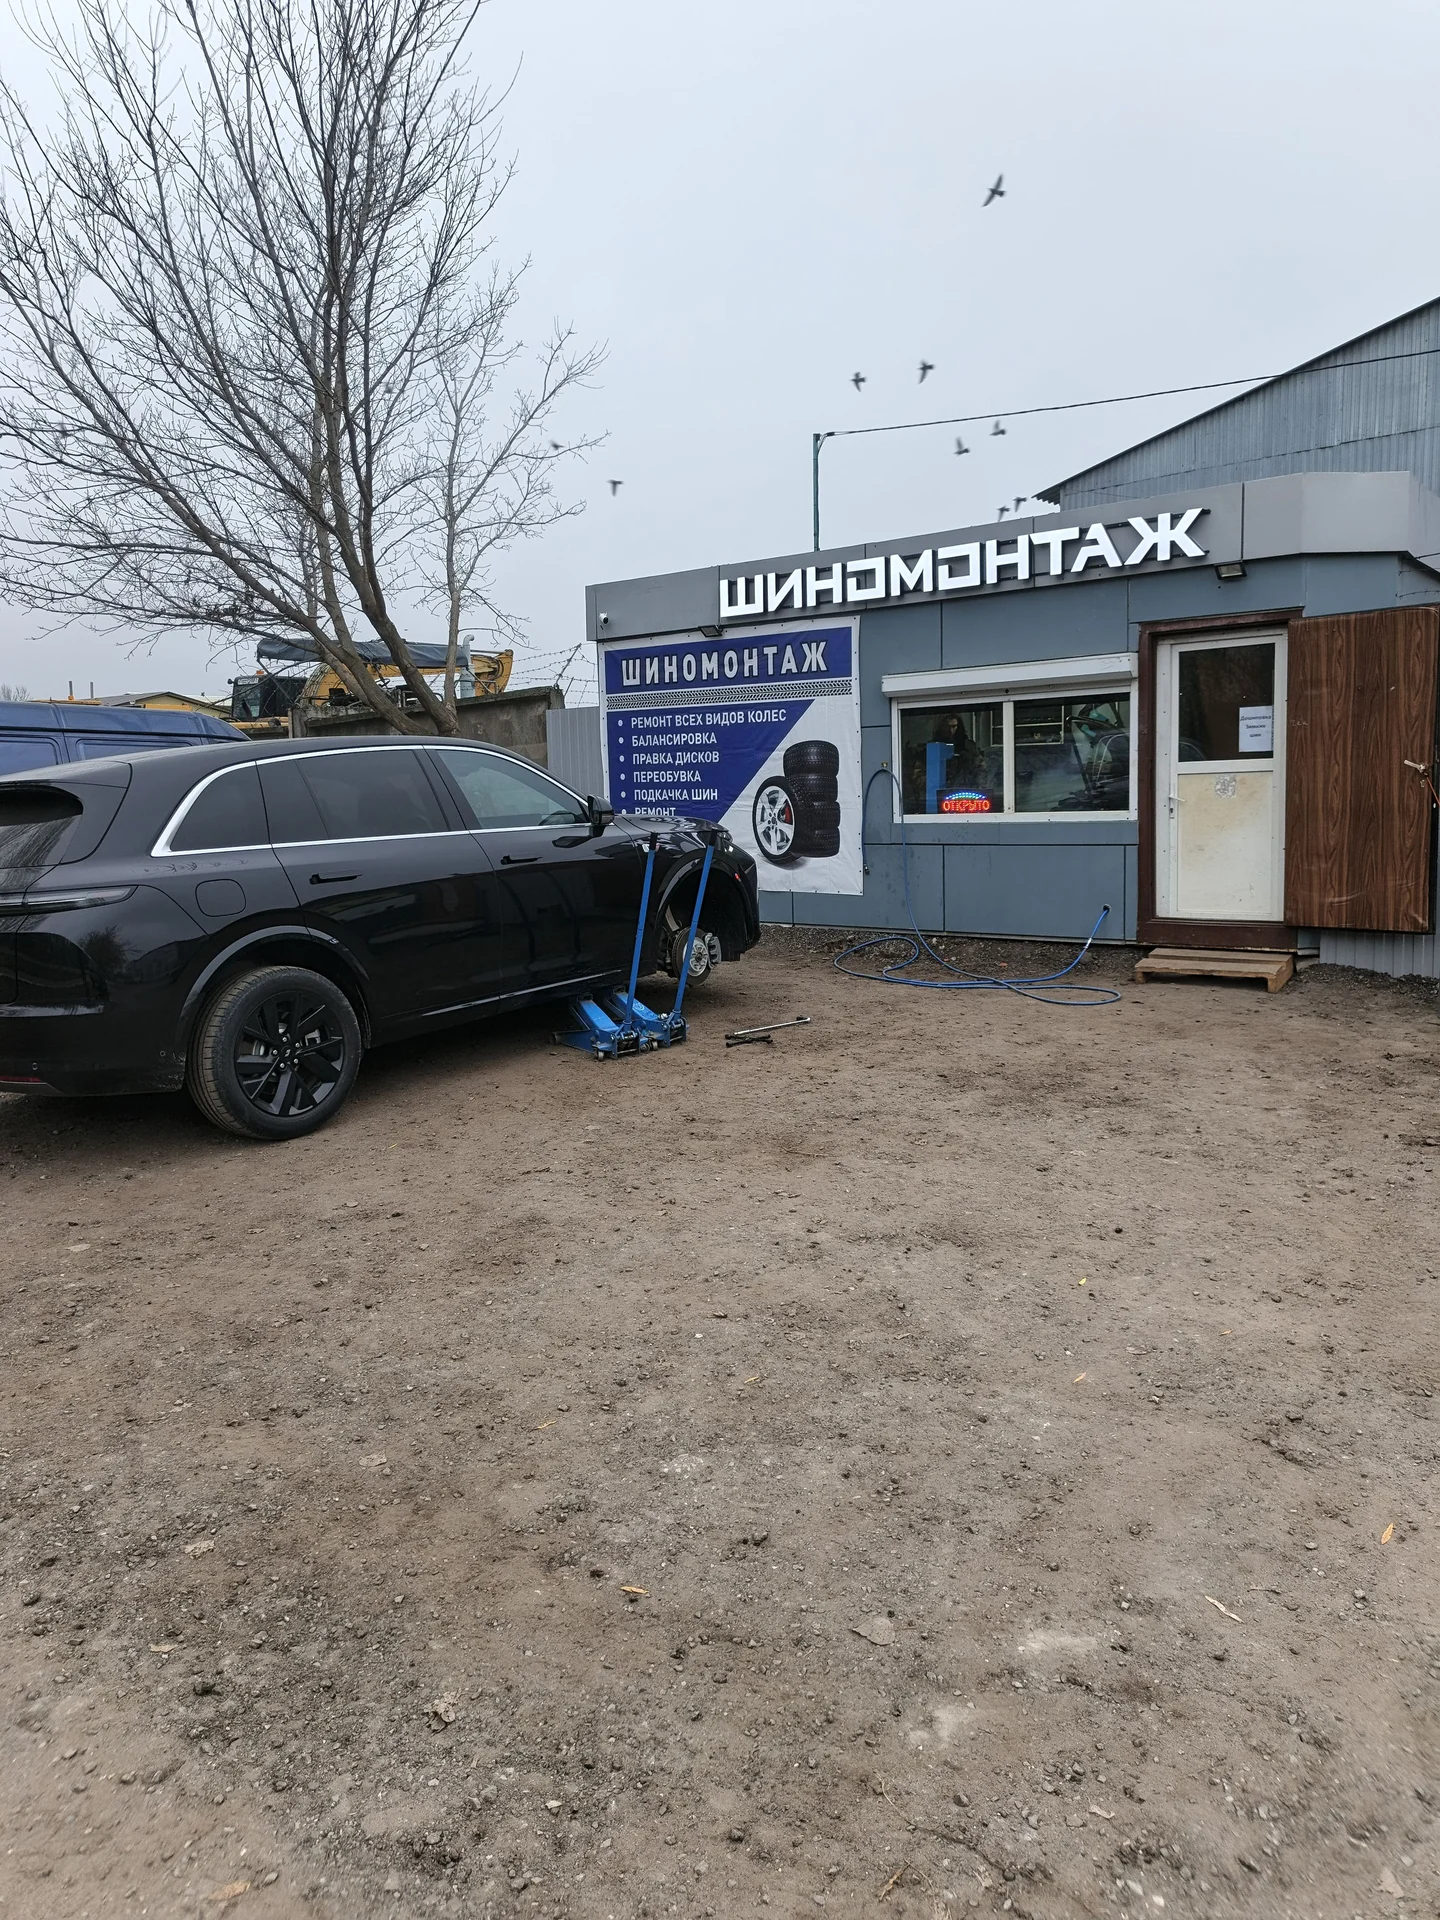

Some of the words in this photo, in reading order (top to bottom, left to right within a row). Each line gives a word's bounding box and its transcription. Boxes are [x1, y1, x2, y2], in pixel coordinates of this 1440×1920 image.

[719, 508, 1206, 618] ШИНОМОНТАЖ
[621, 641, 828, 687] ШИНОМОНТАЖ
[631, 715, 672, 728] РЕМОНТ
[675, 713, 703, 727] ВСЕХ
[706, 711, 745, 726] ВИДОВ
[748, 709, 787, 723] КОЛЕС
[632, 732, 717, 747] БАЛАНСИРОВКА
[632, 752, 673, 765] ПРАВКА
[675, 751, 720, 765] ДИСКОВ
[633, 771, 701, 783] ПЕРЕОБУВКА
[634, 789, 689, 802] ПОДКАЧКА
[691, 788, 718, 800] ШИН
[943, 800, 990, 811] ОТКРЫТО
